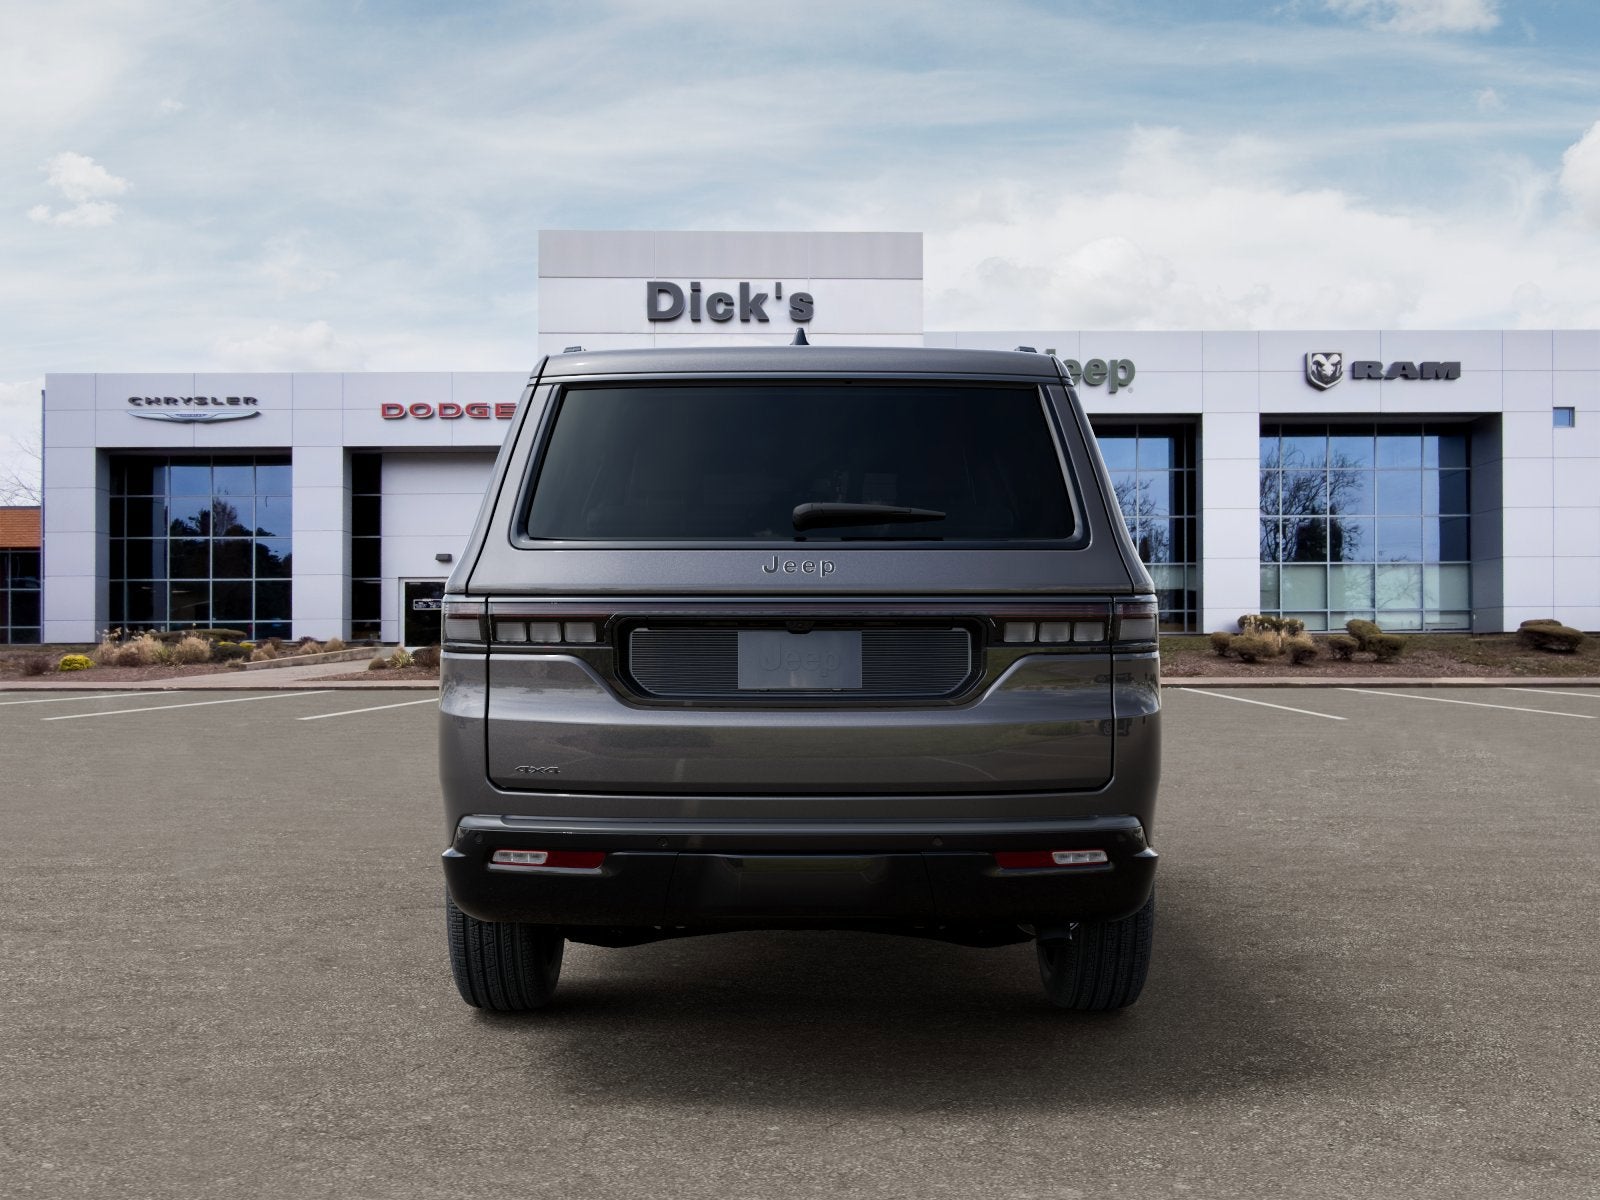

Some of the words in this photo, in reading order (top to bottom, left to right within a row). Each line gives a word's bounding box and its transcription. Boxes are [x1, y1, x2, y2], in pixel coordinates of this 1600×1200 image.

[647, 281, 814, 323] Dick's
[1046, 349, 1136, 394] eep
[1352, 360, 1461, 380] RAM
[128, 396, 258, 406] CHRYSLER
[381, 402, 517, 420] DODGE
[761, 555, 836, 578] Jeep
[759, 640, 841, 678] Jeep
